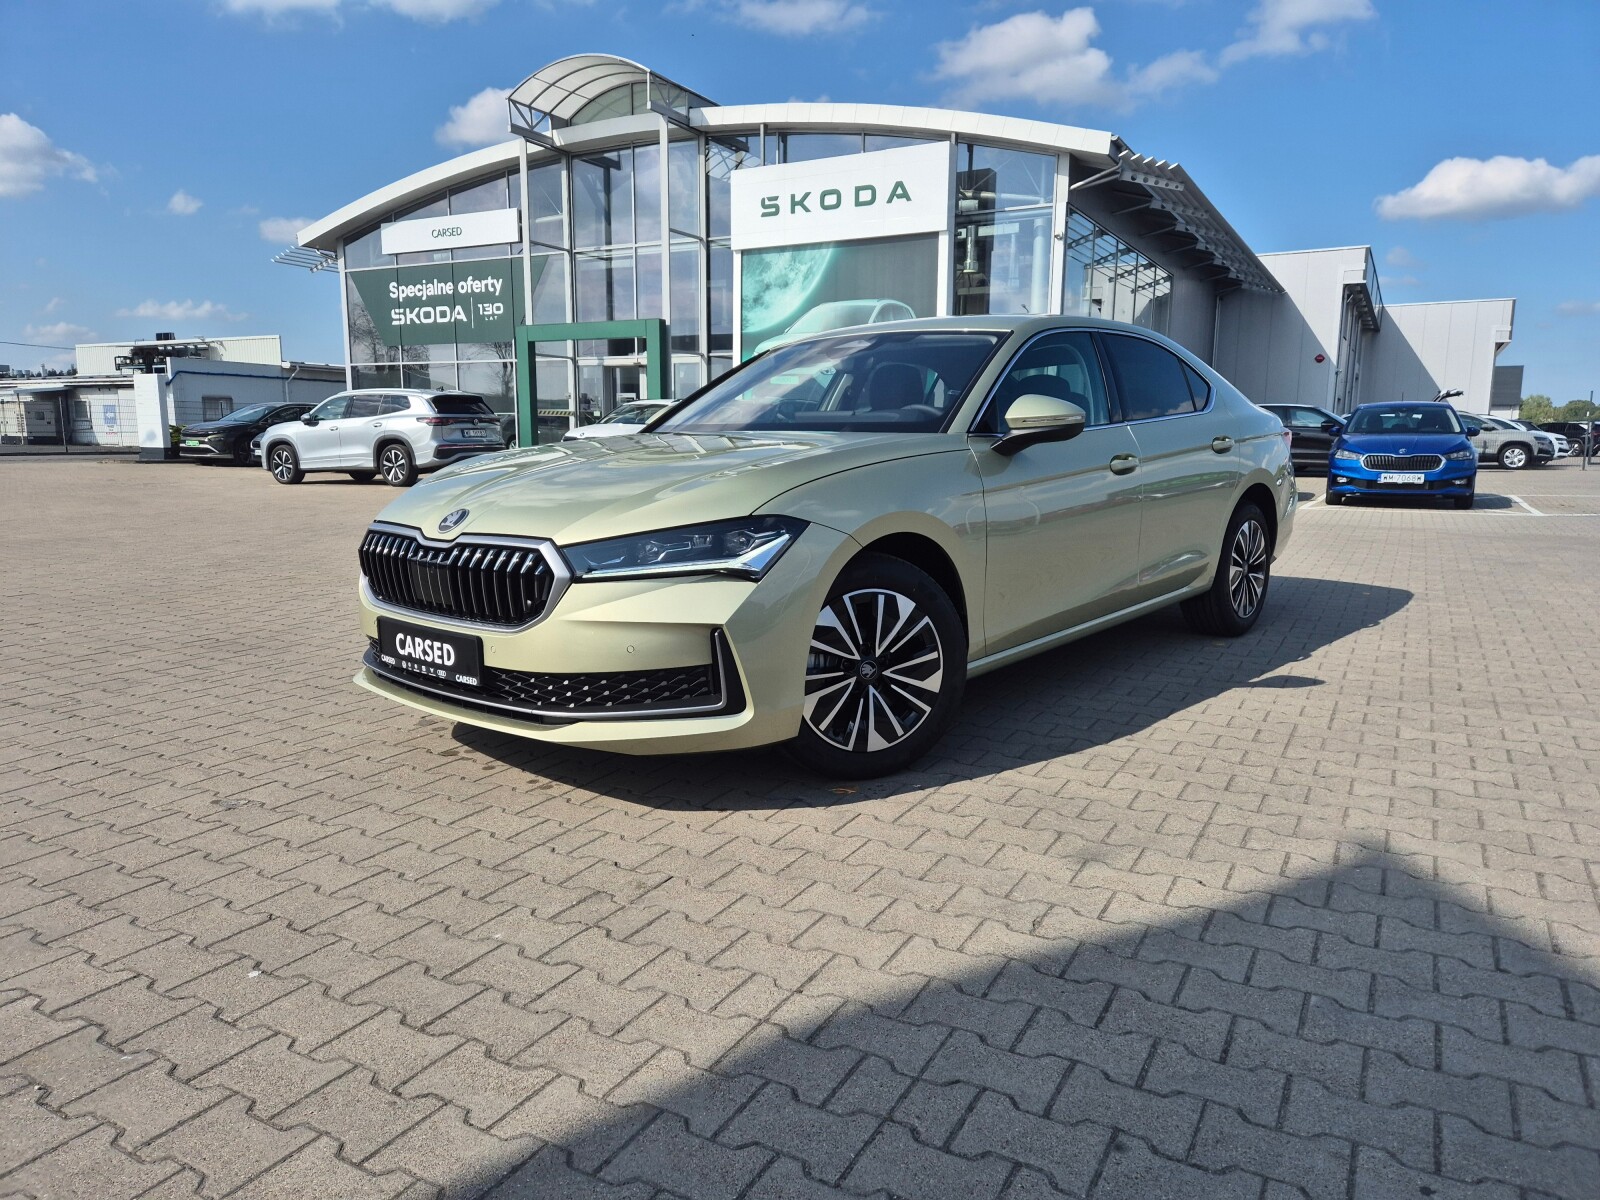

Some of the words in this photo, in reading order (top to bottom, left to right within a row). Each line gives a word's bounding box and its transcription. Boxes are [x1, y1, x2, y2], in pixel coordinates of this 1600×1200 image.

[431, 226, 462, 239] CARSED
[389, 278, 454, 302] Specjalne
[457, 276, 503, 295] oferty
[477, 302, 503, 315] 130
[396, 633, 455, 666] CARSED
[381, 654, 395, 665] CARSED
[455, 674, 477, 685] CARSED
